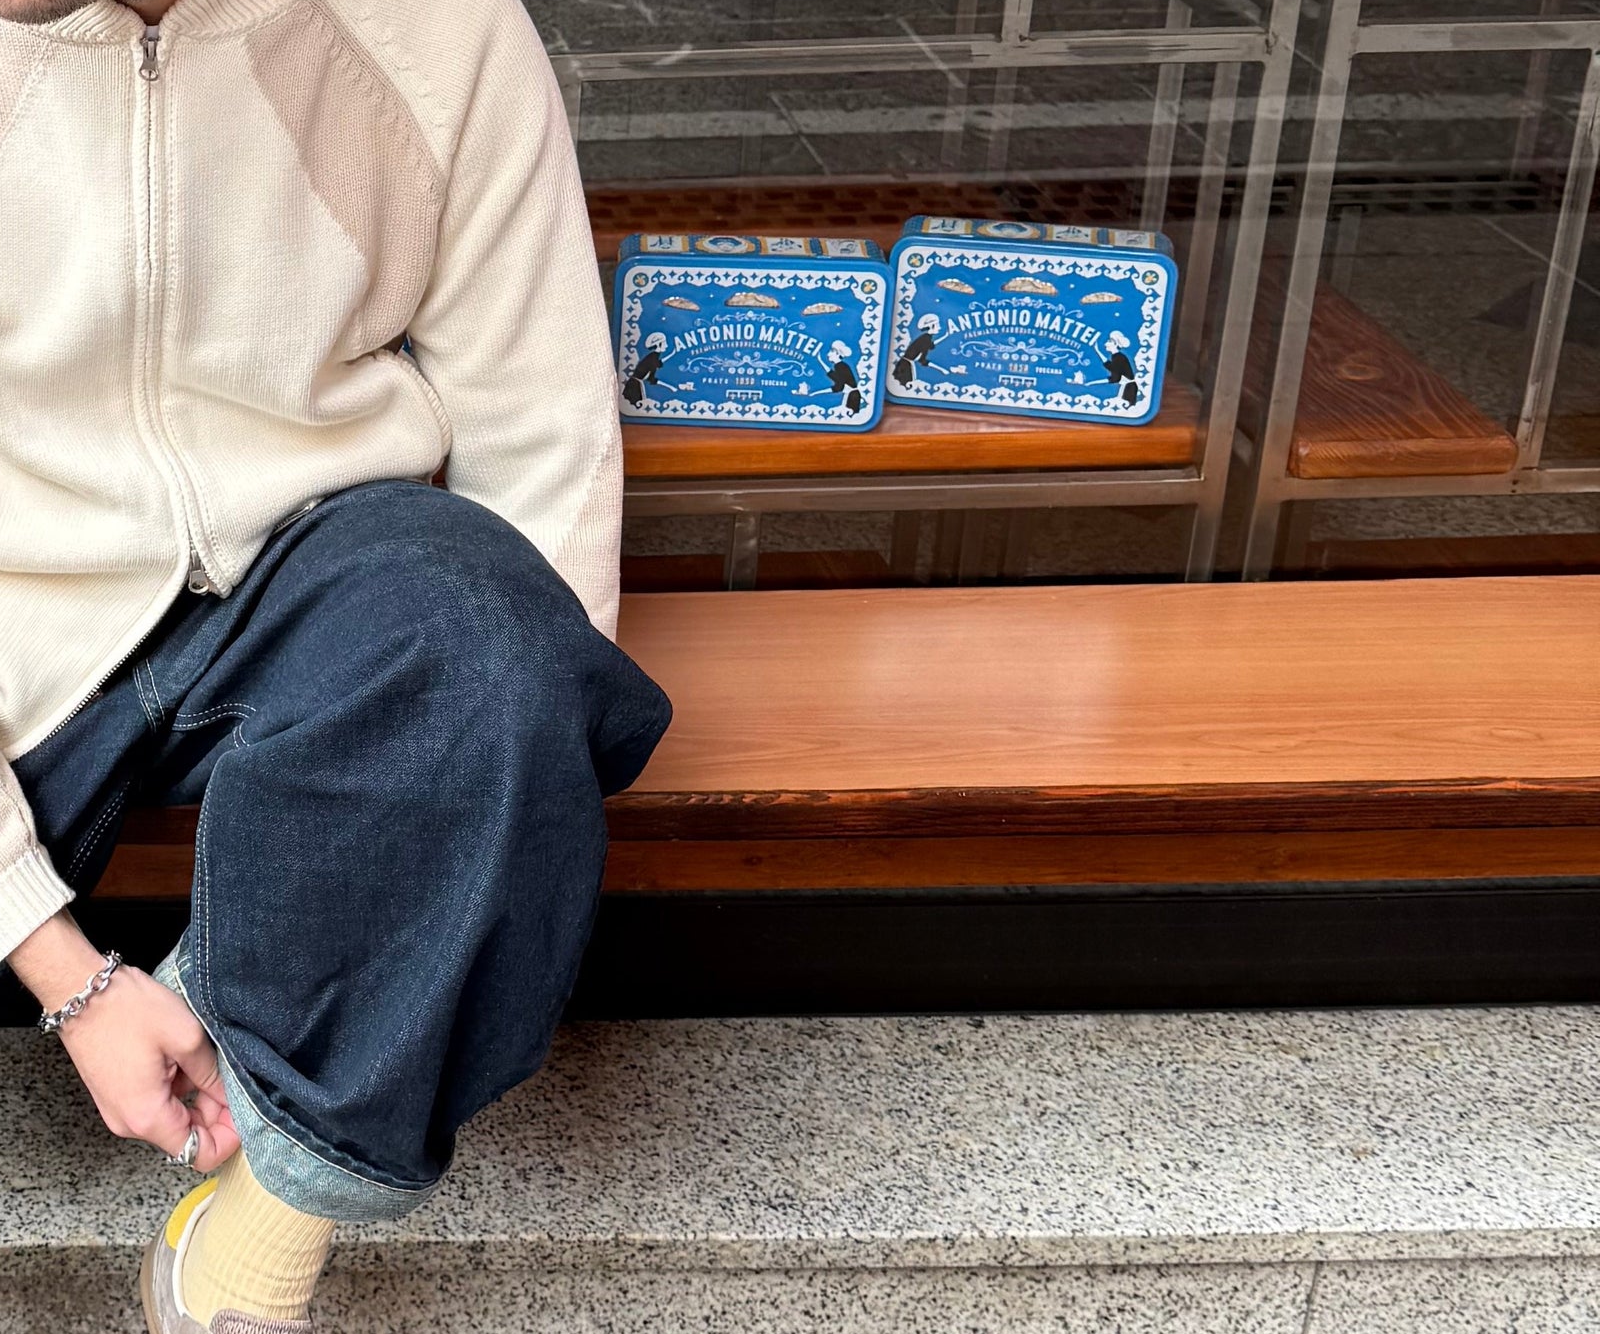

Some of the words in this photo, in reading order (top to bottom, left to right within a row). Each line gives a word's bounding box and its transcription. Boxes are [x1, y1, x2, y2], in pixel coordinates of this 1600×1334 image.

[674, 323, 755, 352] ANTONIO
[759, 324, 823, 357] MATTEI
[948, 309, 1031, 335] ANTONIO
[1034, 311, 1102, 347] MATTEI
